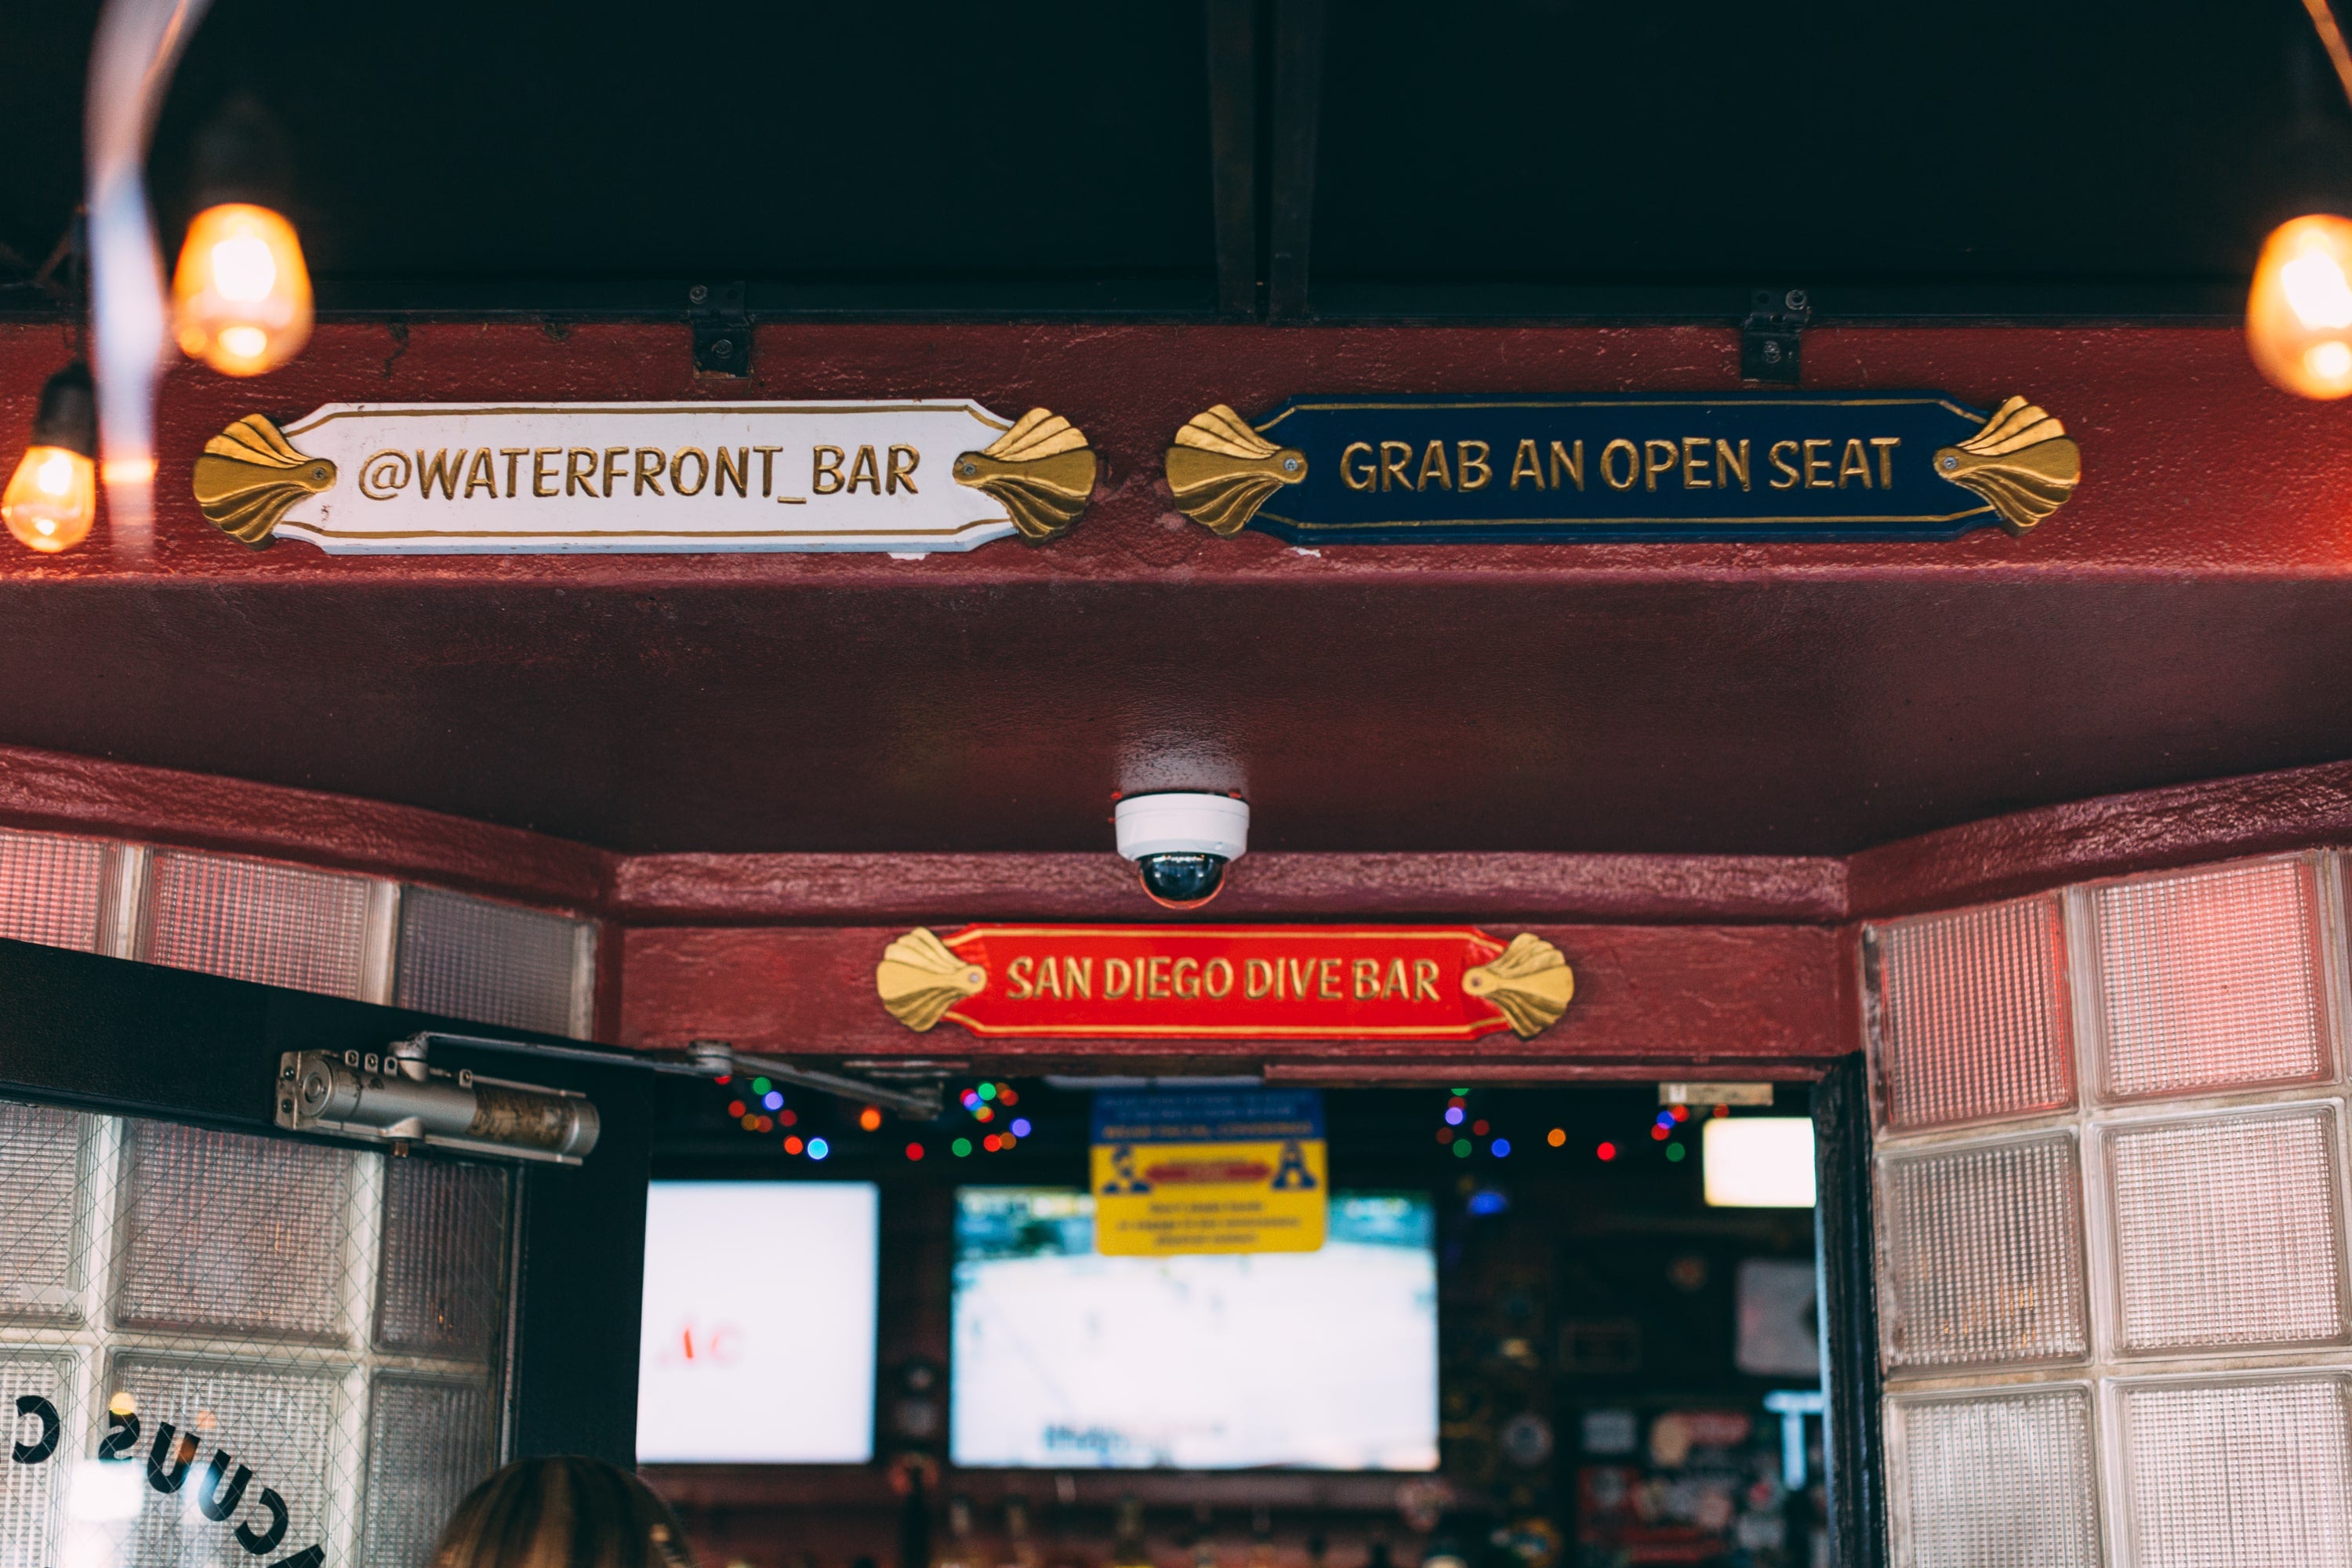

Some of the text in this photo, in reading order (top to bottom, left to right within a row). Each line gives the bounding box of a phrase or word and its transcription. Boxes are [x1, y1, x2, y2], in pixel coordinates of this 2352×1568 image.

[358, 445, 921, 504] @WATERFRONT_BAR
[1340, 437, 1901, 492] GRAB AN OPEN SEAT
[1007, 956, 1441, 1002] SAN DIEGO DIVE BAR
